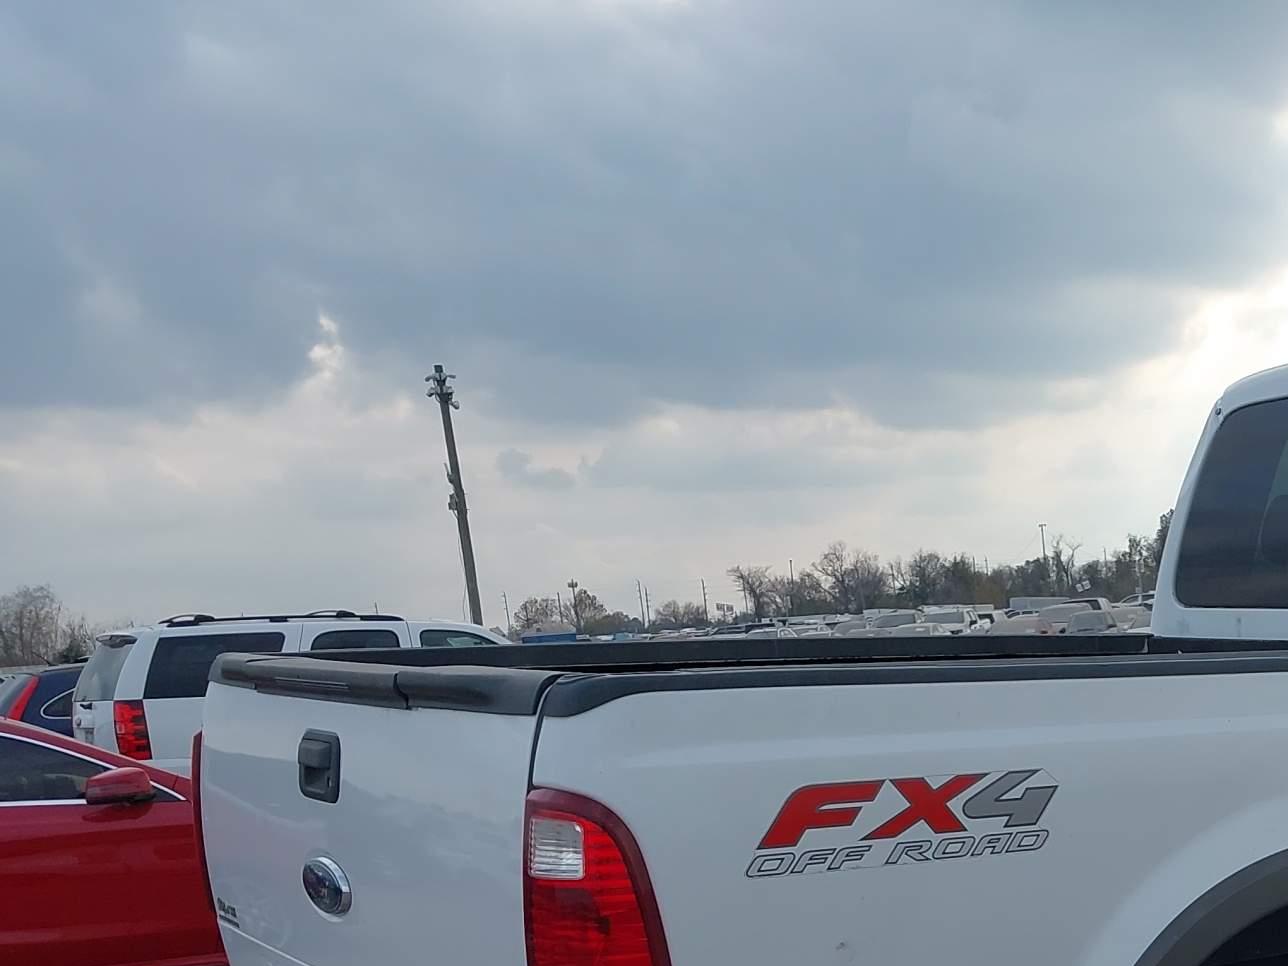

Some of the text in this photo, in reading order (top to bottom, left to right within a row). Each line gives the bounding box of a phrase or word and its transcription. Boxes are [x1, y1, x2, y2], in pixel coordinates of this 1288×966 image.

[756, 768, 1059, 850] FX4
[746, 829, 1049, 878] OFF ROAD
